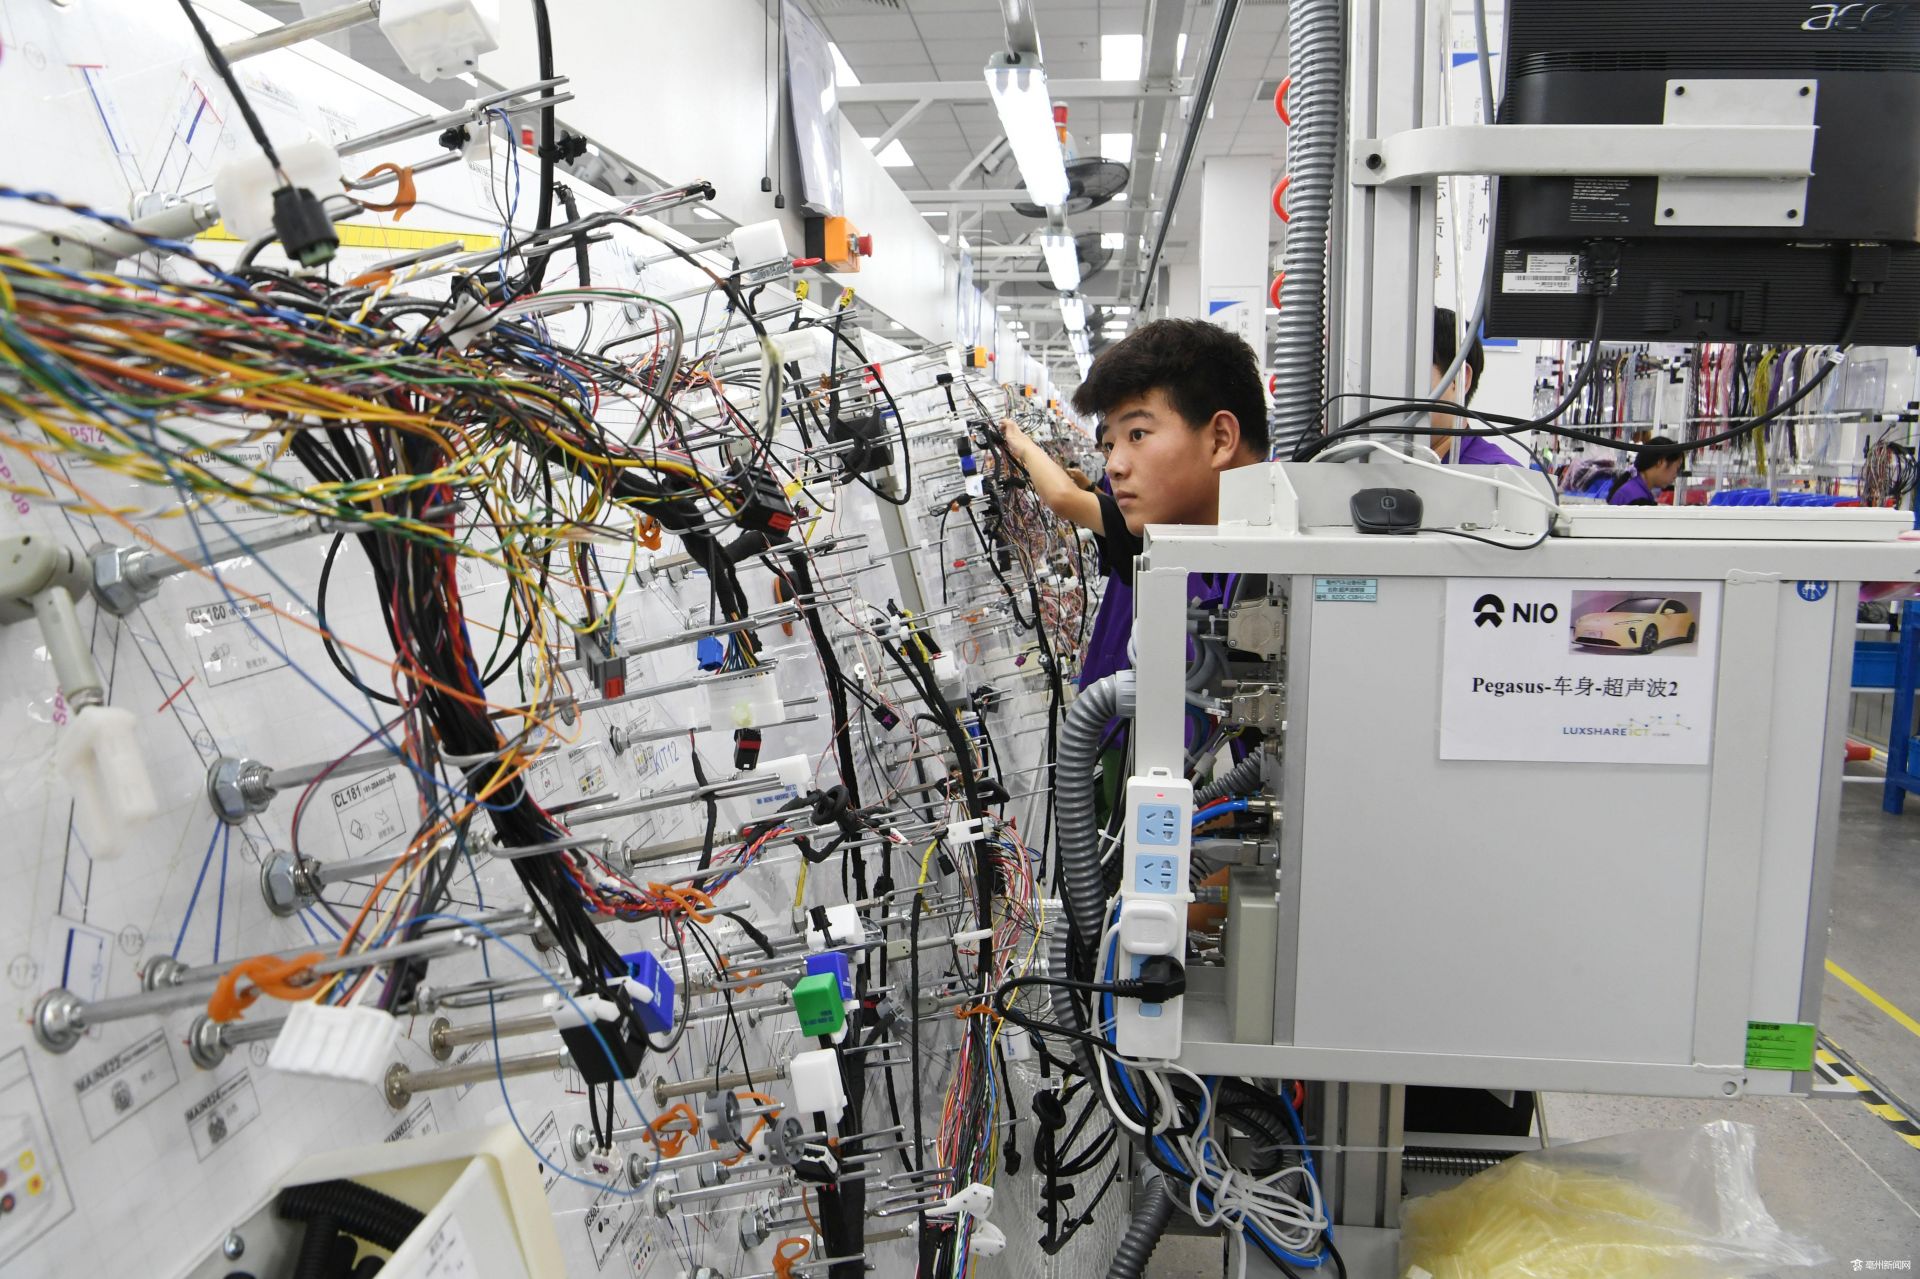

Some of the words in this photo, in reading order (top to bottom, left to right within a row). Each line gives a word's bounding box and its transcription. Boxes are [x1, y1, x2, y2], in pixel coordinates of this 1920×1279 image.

[1512, 603, 1559, 624] NIO
[1472, 676, 1679, 698] Pegasus-车身-超声波2
[1563, 726, 1627, 736] LUXSHARE
[334, 784, 362, 808] CL181
